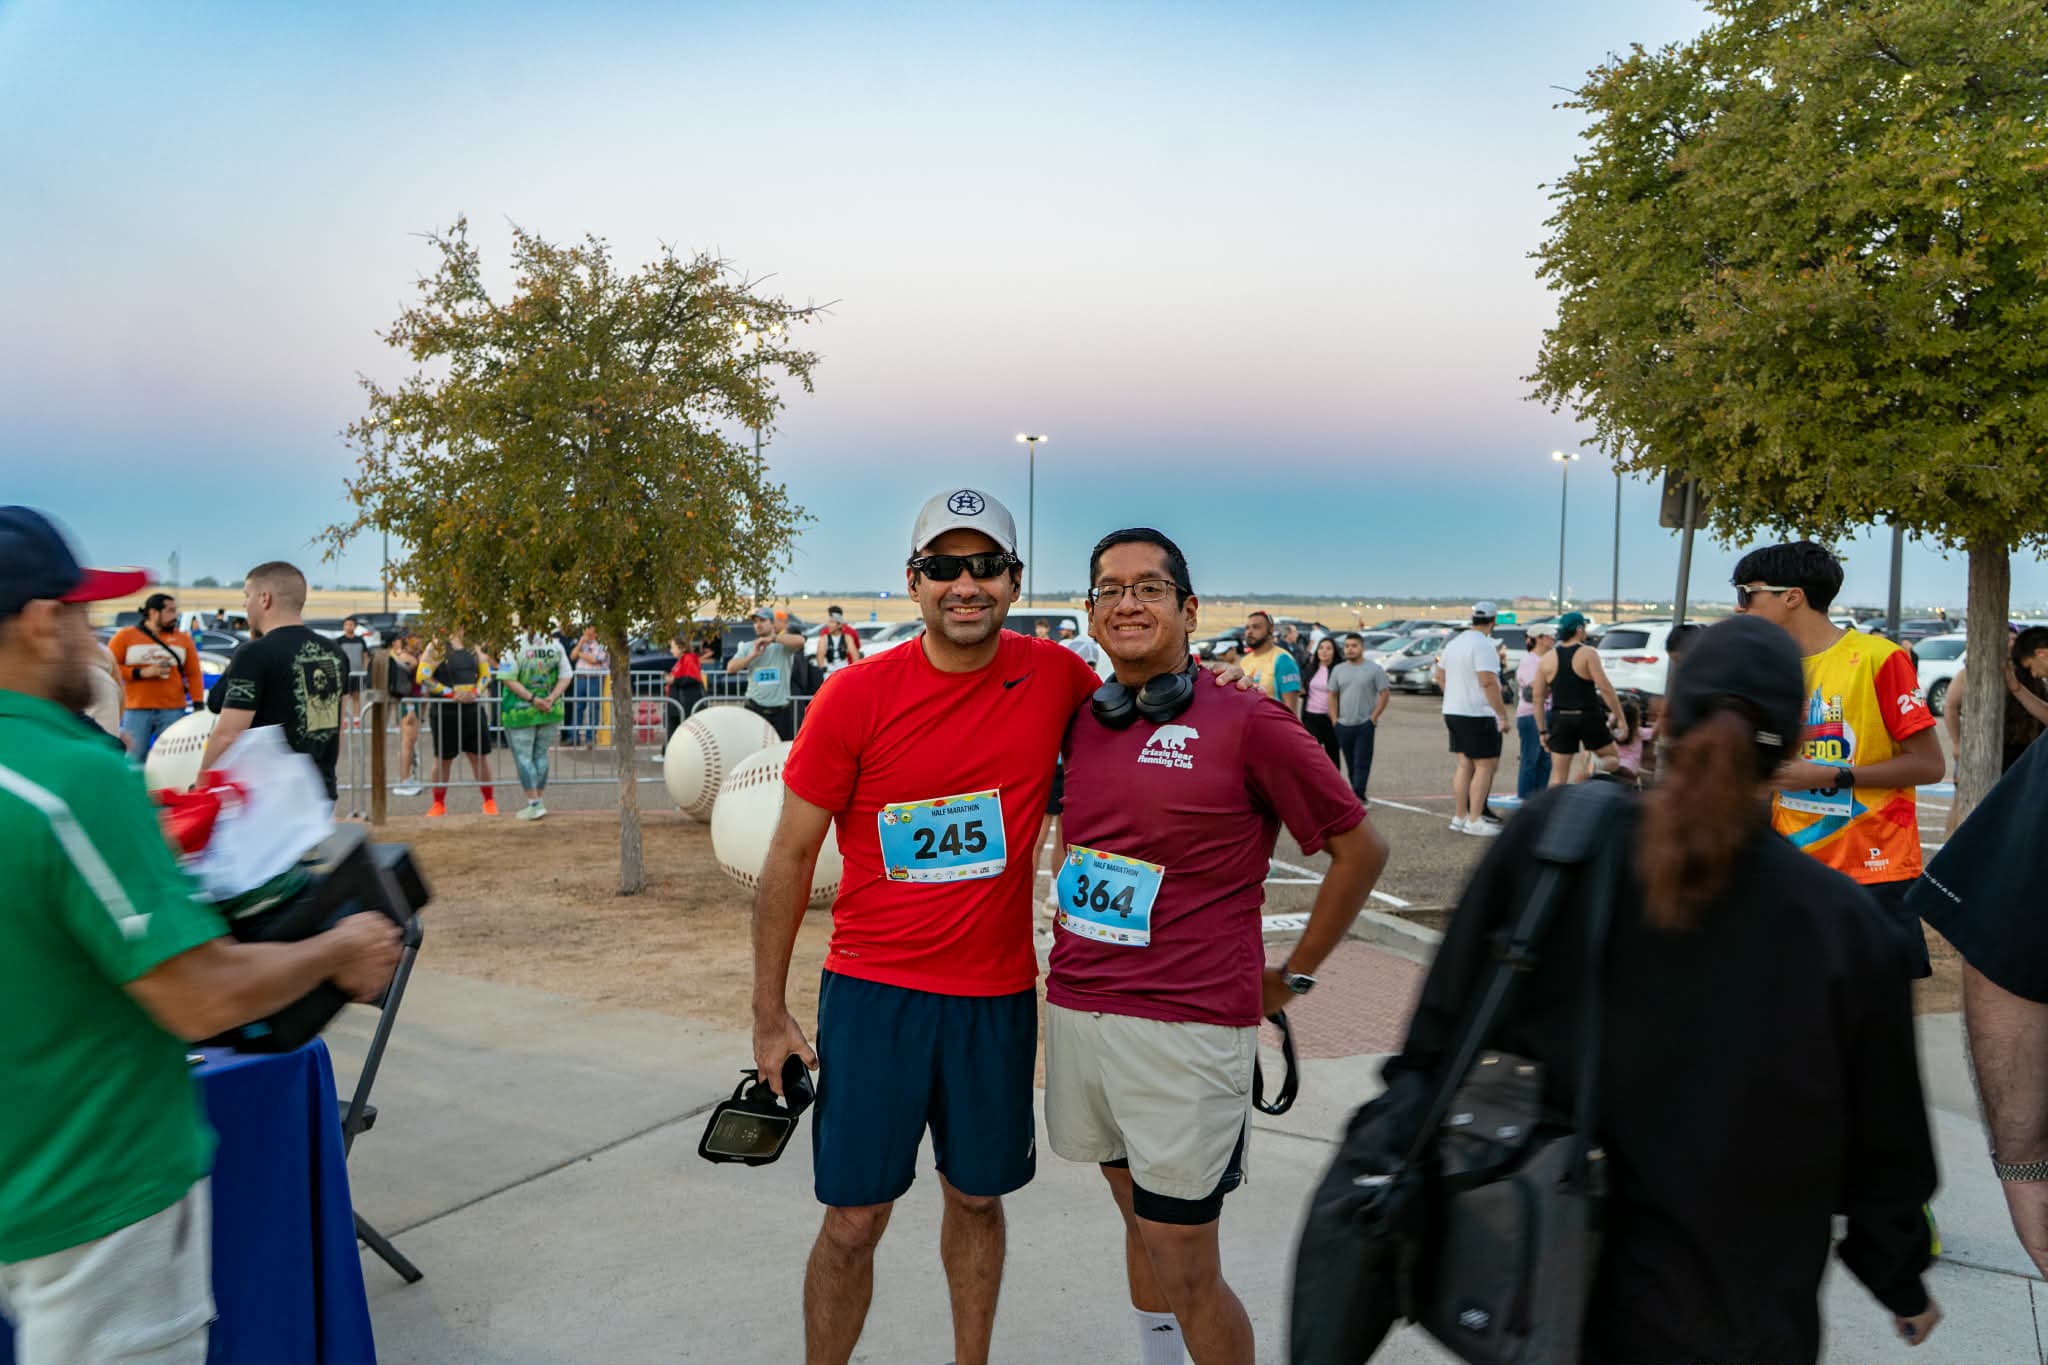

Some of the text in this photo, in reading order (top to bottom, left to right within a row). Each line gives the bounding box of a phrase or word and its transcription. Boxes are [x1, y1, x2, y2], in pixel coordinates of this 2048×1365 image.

[1138, 755, 1193, 769] Running Club
[1171, 750, 1194, 761] Bear
[931, 803, 980, 817] HALF MARATHON
[913, 820, 987, 860] 245
[1093, 860, 1140, 877] HALF MARATHON
[1073, 874, 1135, 918] 364
